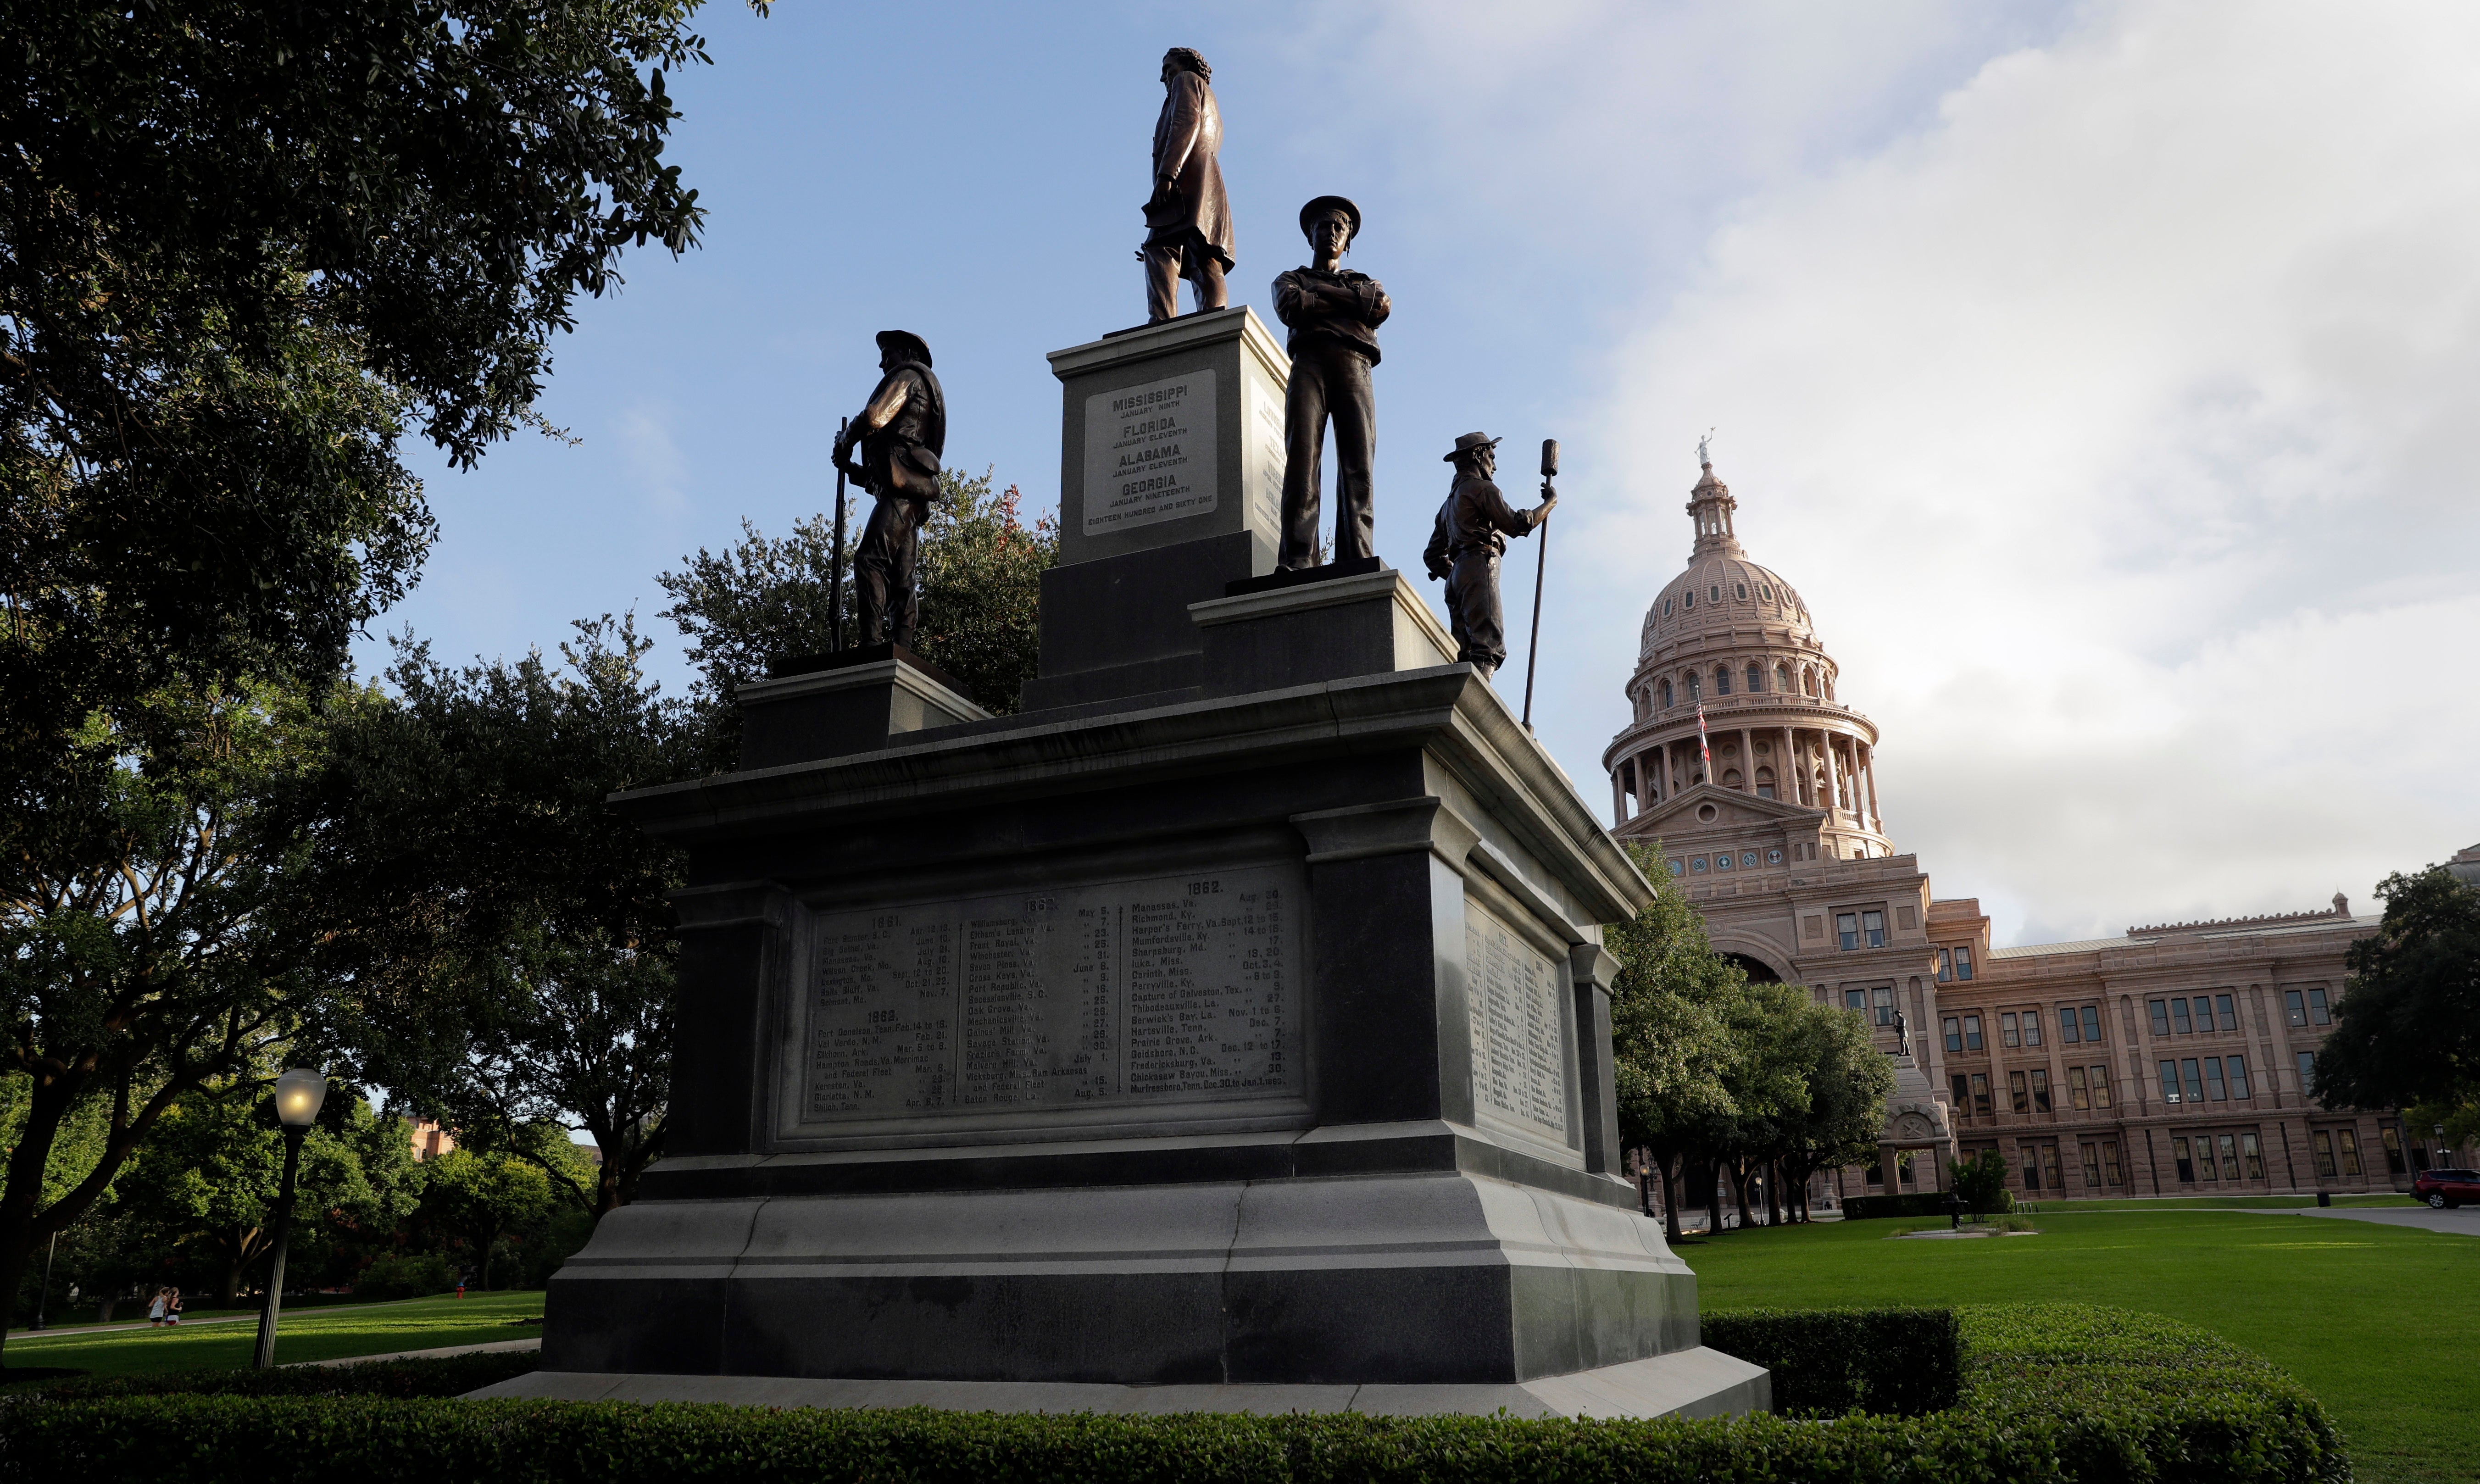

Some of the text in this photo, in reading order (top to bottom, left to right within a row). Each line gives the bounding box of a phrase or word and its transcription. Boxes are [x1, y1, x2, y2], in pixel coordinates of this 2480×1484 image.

[1113, 384, 1187, 411] MISSISSIPPI
[1121, 400, 1180, 418] JANUARY NINTH
[1124, 417, 1176, 438] FLORIDA
[1113, 428, 1187, 449] JANUARY ELEVENTH
[1119, 444, 1180, 467] ALABAMA
[1113, 456, 1188, 478] JANUARY ELEVENTH
[1123, 474, 1176, 495] GEORGIA
[1110, 485, 1190, 507] JANUARY NINETEENTH
[1089, 495, 1212, 525] EIGHTEEN HUNDRED AND SIXTY ONE
[1187, 880, 1223, 895] 1862.
[1079, 908, 1094, 918] May
[1132, 909, 1195, 924] Richmond, Ky.
[1101, 917, 1109, 926] 7.
[1132, 923, 1170, 936] Harper's
[1177, 919, 1203, 933] Ferry,
[1206, 918, 1220, 928] Va.
[916, 936, 934, 945] June
[1197, 930, 1210, 942] Ky.
[1244, 926, 1254, 935] 14
[1257, 926, 1266, 934] to
[917, 946, 934, 957] July
[1190, 942, 1207, 952] Md.
[1269, 935, 1283, 945] 17.
[1160, 947, 1283, 966] Miss. 20.
[969, 962, 990, 972] Seven
[969, 962, 1093, 982] Cross June
[1169, 966, 1192, 976] Miss.
[1243, 960, 1261, 970] Oct.
[919, 987, 949, 998] Nov. 7.
[969, 984, 985, 993] Port
[1132, 978, 1178, 992] Perryville,
[1181, 977, 1194, 988] Ky.
[1132, 984, 1241, 1003] Capture of Galveston, Tex.
[1204, 998, 1219, 1007] La.
[1267, 993, 1284, 1003] 27.
[867, 1009, 898, 1023] 1862.
[968, 1006, 983, 1015] Oak
[1132, 1006, 1269, 1024] Berwick's Bay, La. Nov. 1 to
[817, 1029, 834, 1038] Fort
[913, 1021, 922, 1030] 14
[925, 1021, 932, 1029] to
[1131, 1016, 1284, 1036] Hartsville, Tenn. Dec. 7.
[817, 1039, 829, 1048] Val
[916, 1032, 933, 1041] Feb.
[967, 1038, 996, 1049] Savage
[1131, 1037, 1160, 1047] Prairie
[1198, 1033, 1217, 1042] Ark.
[1274, 1028, 1285, 1037] 7.
[851, 1047, 868, 1056] Ark.
[897, 1044, 914, 1053] Mar.
[1222, 1043, 1240, 1052] Dec.
[1260, 1041, 1268, 1050] to
[1271, 1040, 1285, 1049] 17.
[816, 1059, 849, 1071] Hampton
[894, 1053, 928, 1064] Merrimac
[967, 1053, 1091, 1070] Malvern July
[1131, 1057, 1197, 1073] Fredericksburg,
[1201, 1056, 1216, 1066] Va.
[841, 1068, 868, 1078] Federal
[873, 1067, 892, 1076] Fleet
[916, 1064, 933, 1073] Mar.
[1033, 1065, 1087, 1077] Ram Arkansas
[1131, 1063, 1285, 1082] Chickasaw Bayou, Miss. 30.
[973, 1079, 1045, 1092] and Federal Fleet
[1184, 1081, 1203, 1091] Tenn.
[965, 1094, 987, 1103] Baton
[1074, 1088, 1094, 1100] Aug.
